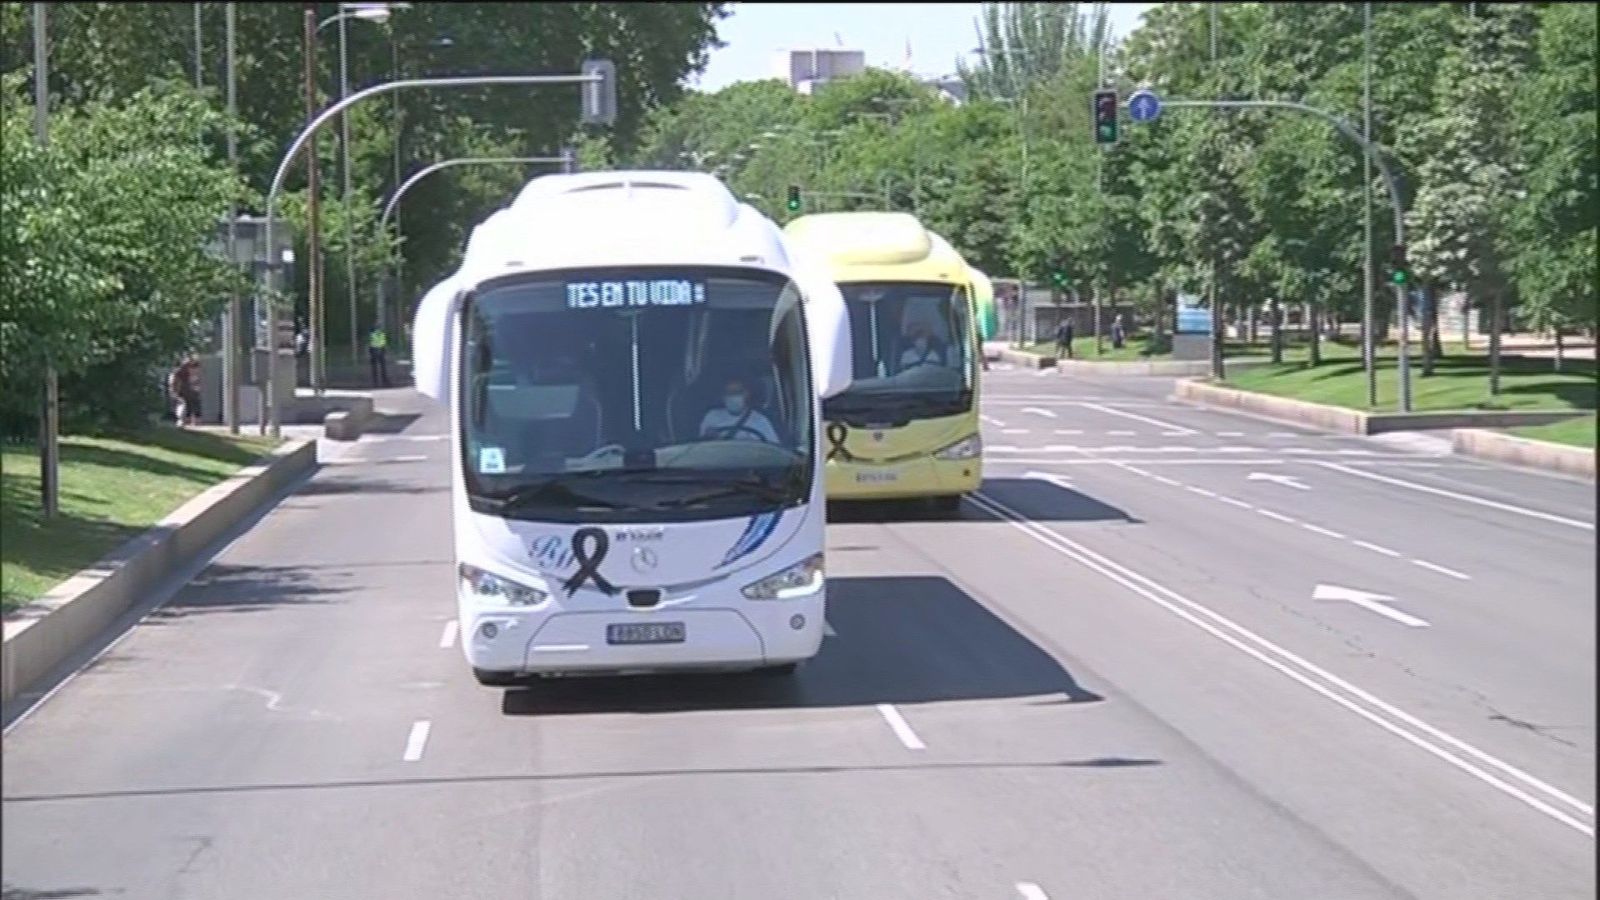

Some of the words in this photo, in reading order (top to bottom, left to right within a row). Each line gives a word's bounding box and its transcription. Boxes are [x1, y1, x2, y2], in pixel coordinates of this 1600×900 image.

[567, 282, 599, 307] TES
[602, 281, 624, 306] EN
[626, 280, 648, 305] TU
[650, 279, 692, 305] VIDA
